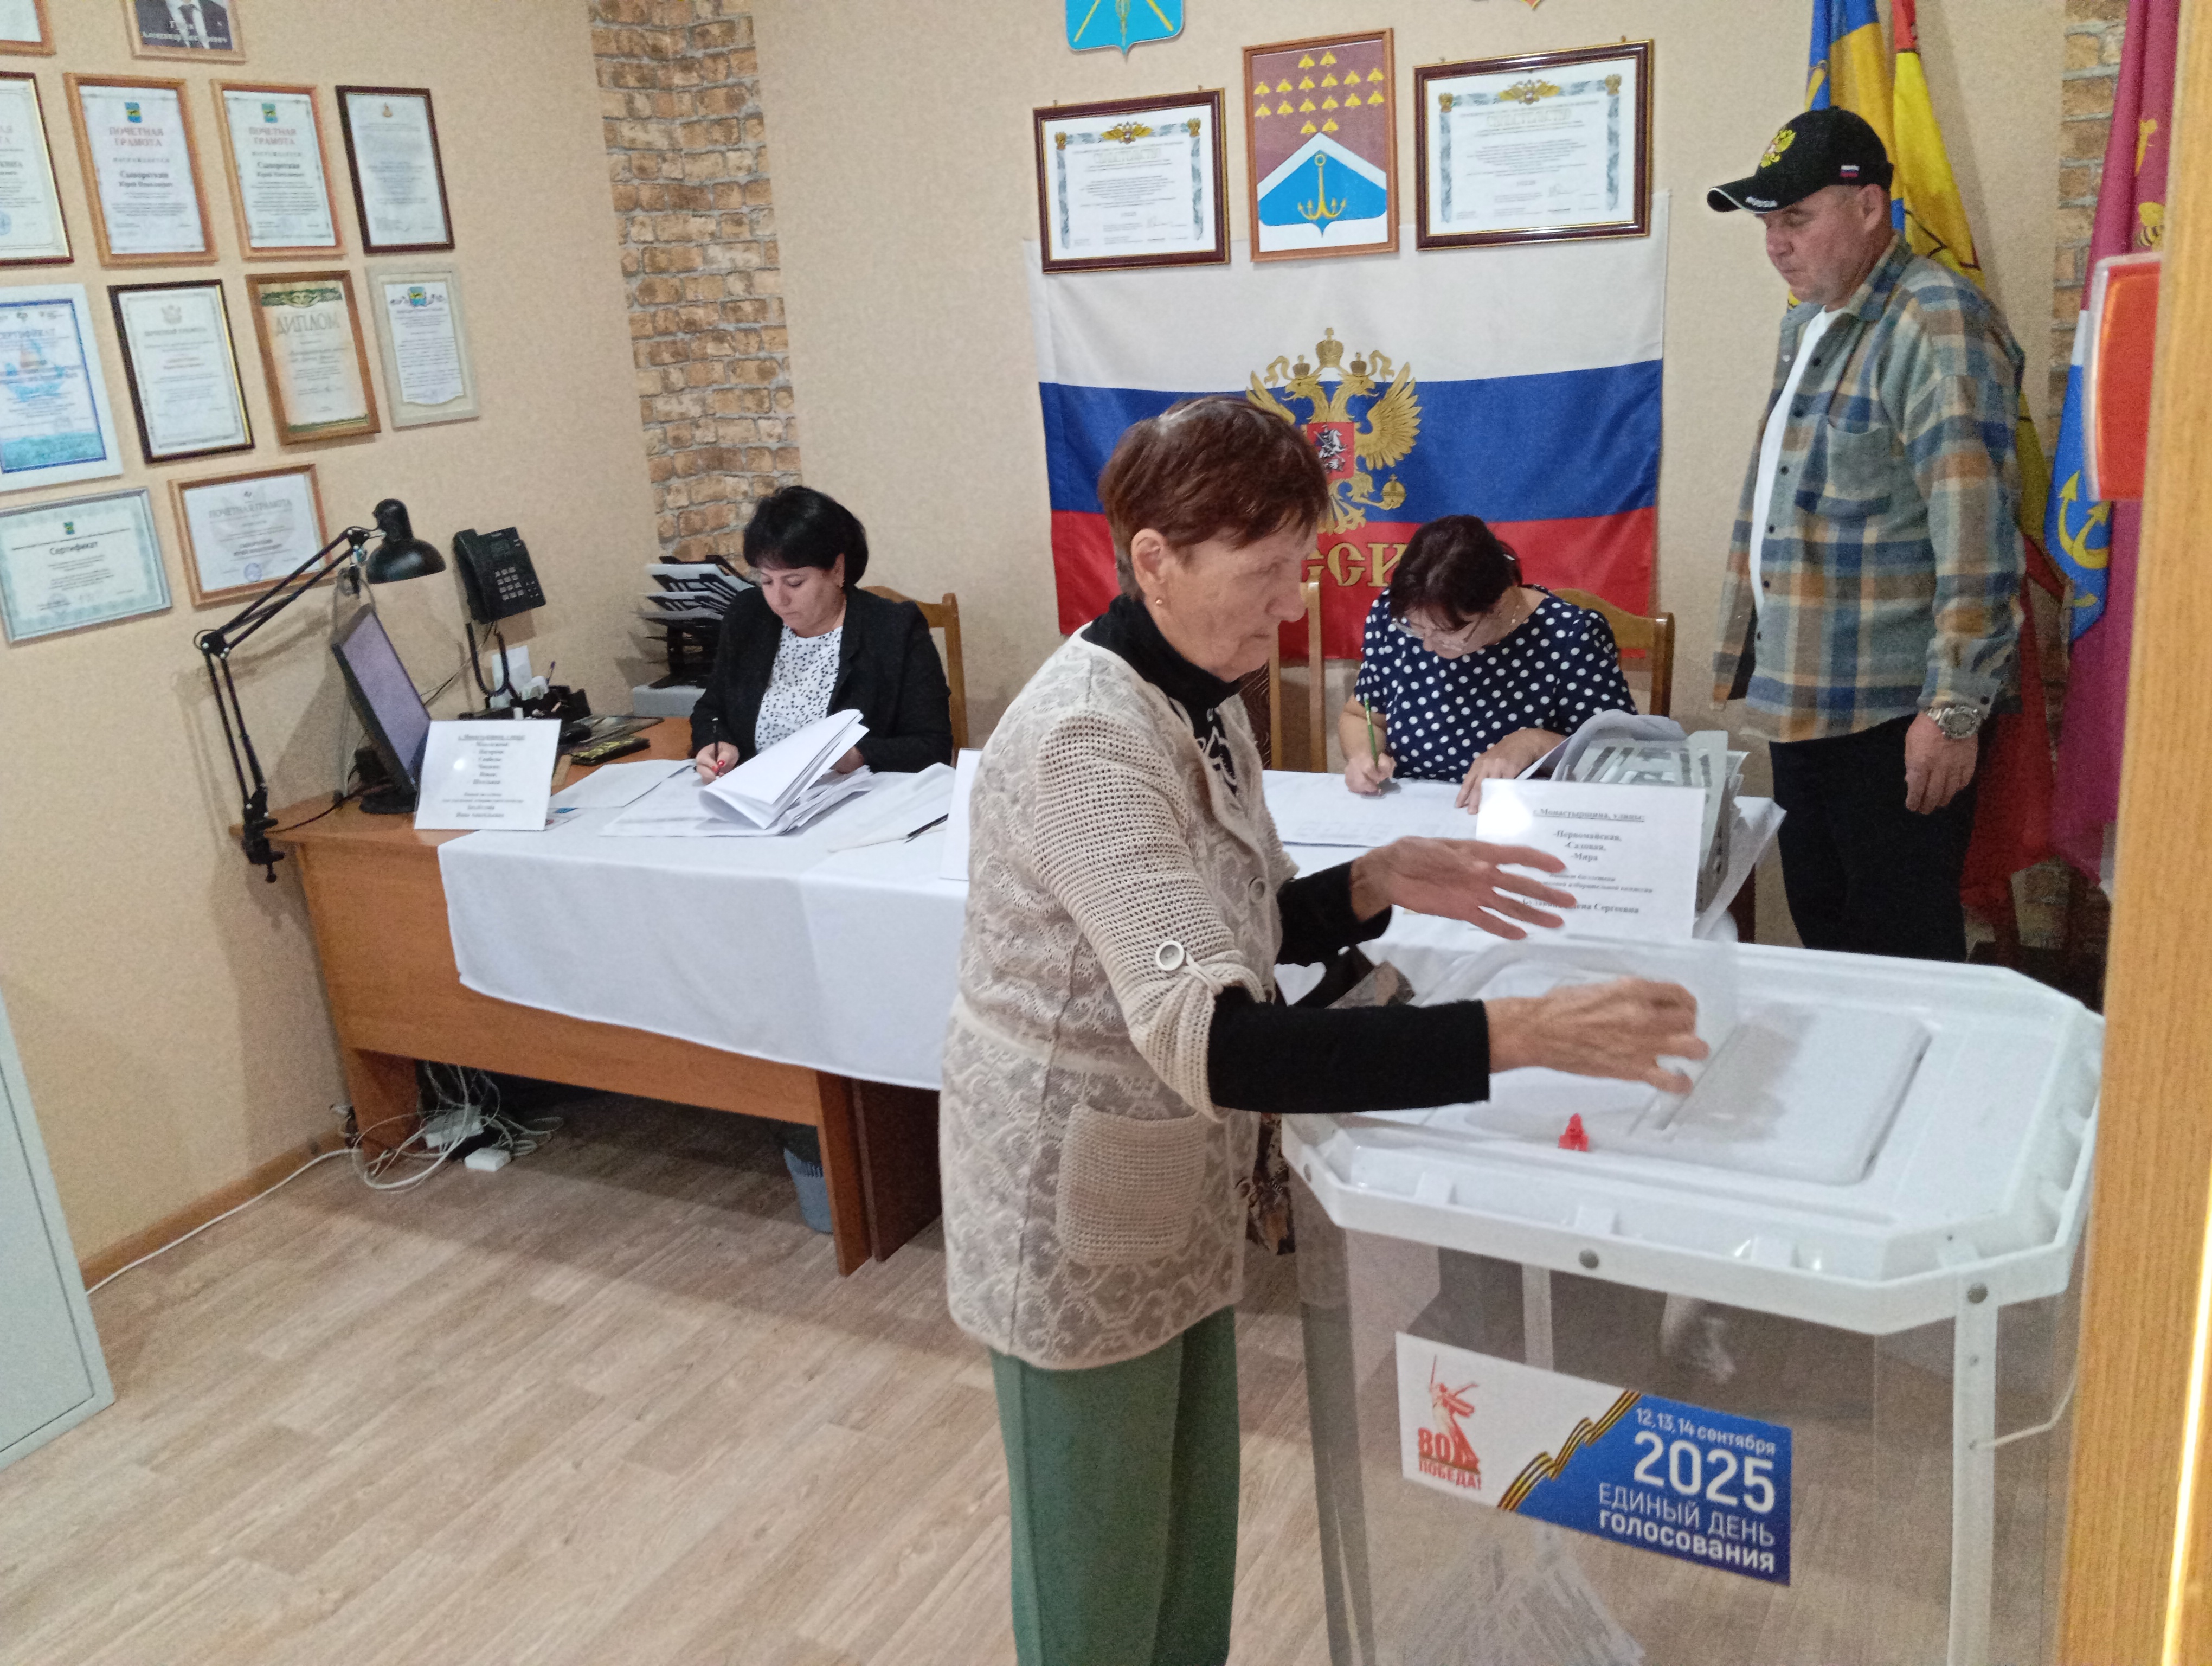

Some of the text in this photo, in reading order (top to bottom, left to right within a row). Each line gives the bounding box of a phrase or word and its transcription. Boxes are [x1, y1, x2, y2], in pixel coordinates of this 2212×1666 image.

[1636, 1407, 1776, 1456] 12,13,14 сентября
[1633, 1430, 1776, 1514] 2025
[1598, 1482, 1776, 1547] ЕДИНЫЙ ДЕНЬ
